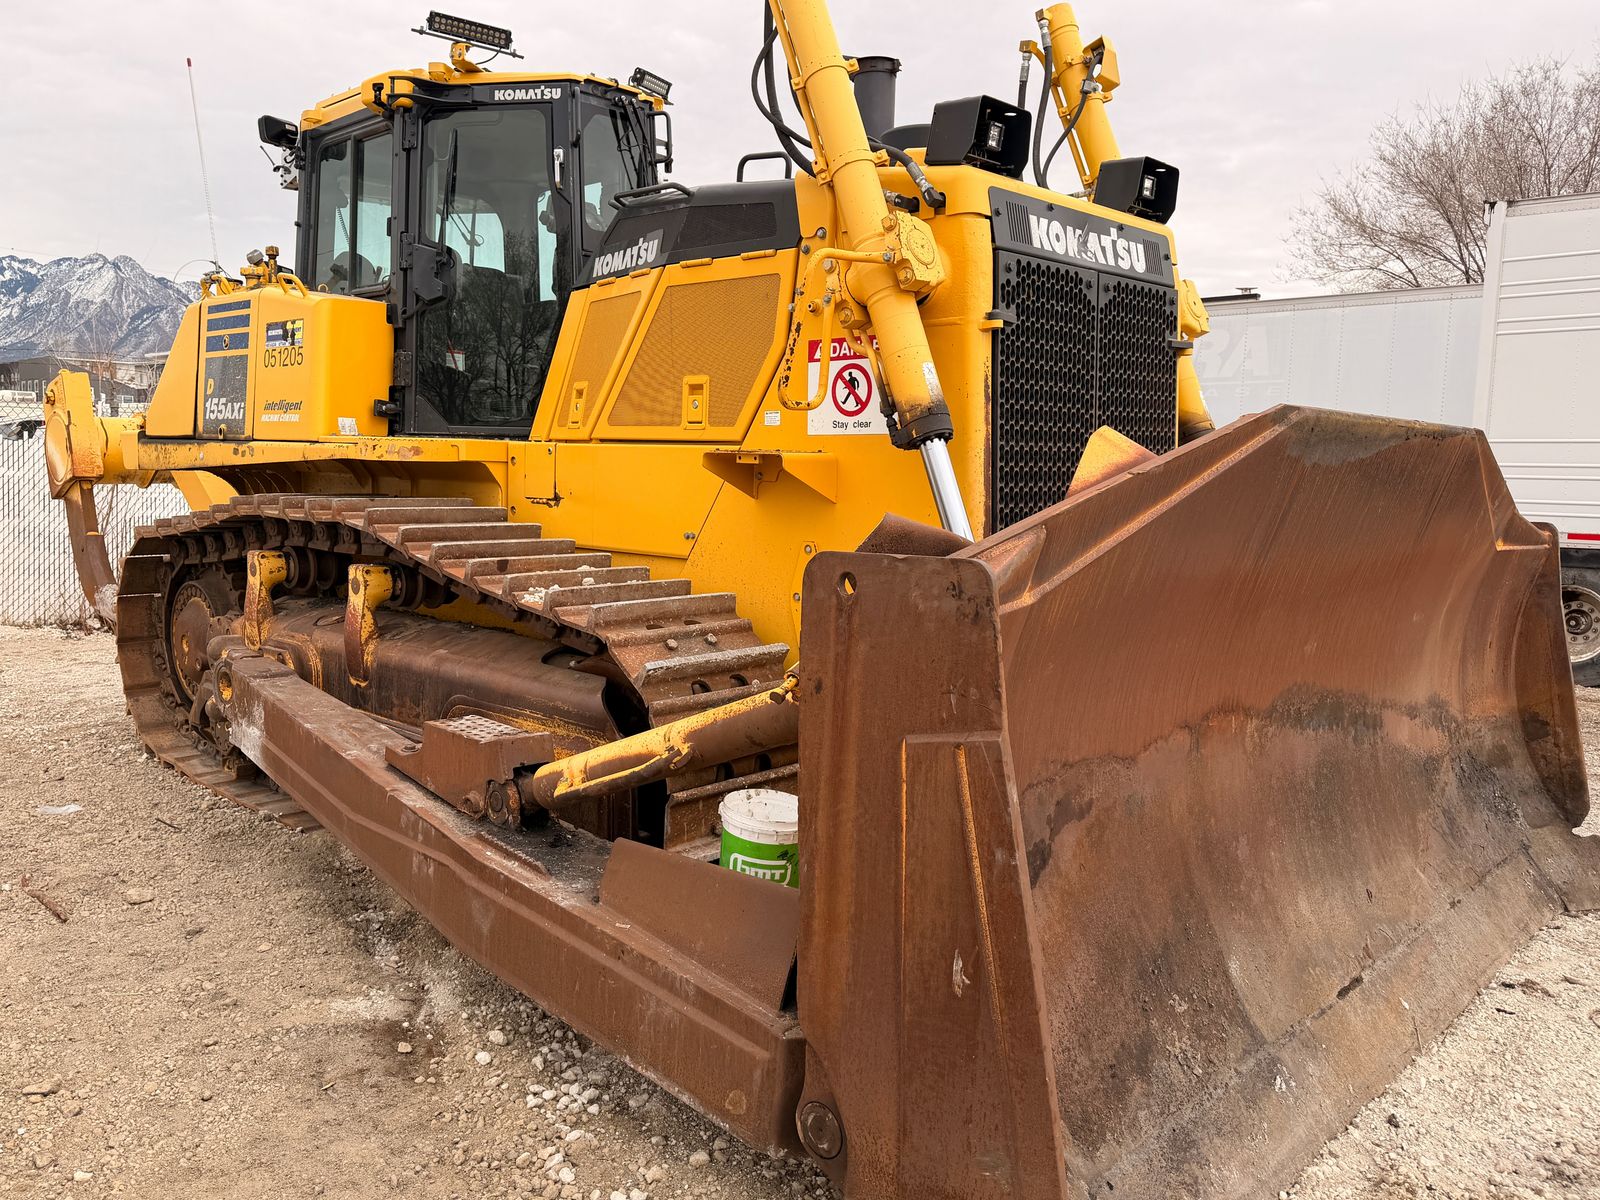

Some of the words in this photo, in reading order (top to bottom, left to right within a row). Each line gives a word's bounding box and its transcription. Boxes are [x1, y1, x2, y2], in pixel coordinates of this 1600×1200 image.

[494, 85, 562, 100] KOMATSU
[592, 238, 659, 277] KOMATSU
[263, 347, 304, 368] 051205
[207, 378, 214, 395] D
[205, 397, 244, 420] 155AXi
[264, 400, 302, 413] intelligent
[832, 420, 849, 430] Stay
[853, 420, 872, 428] clear
